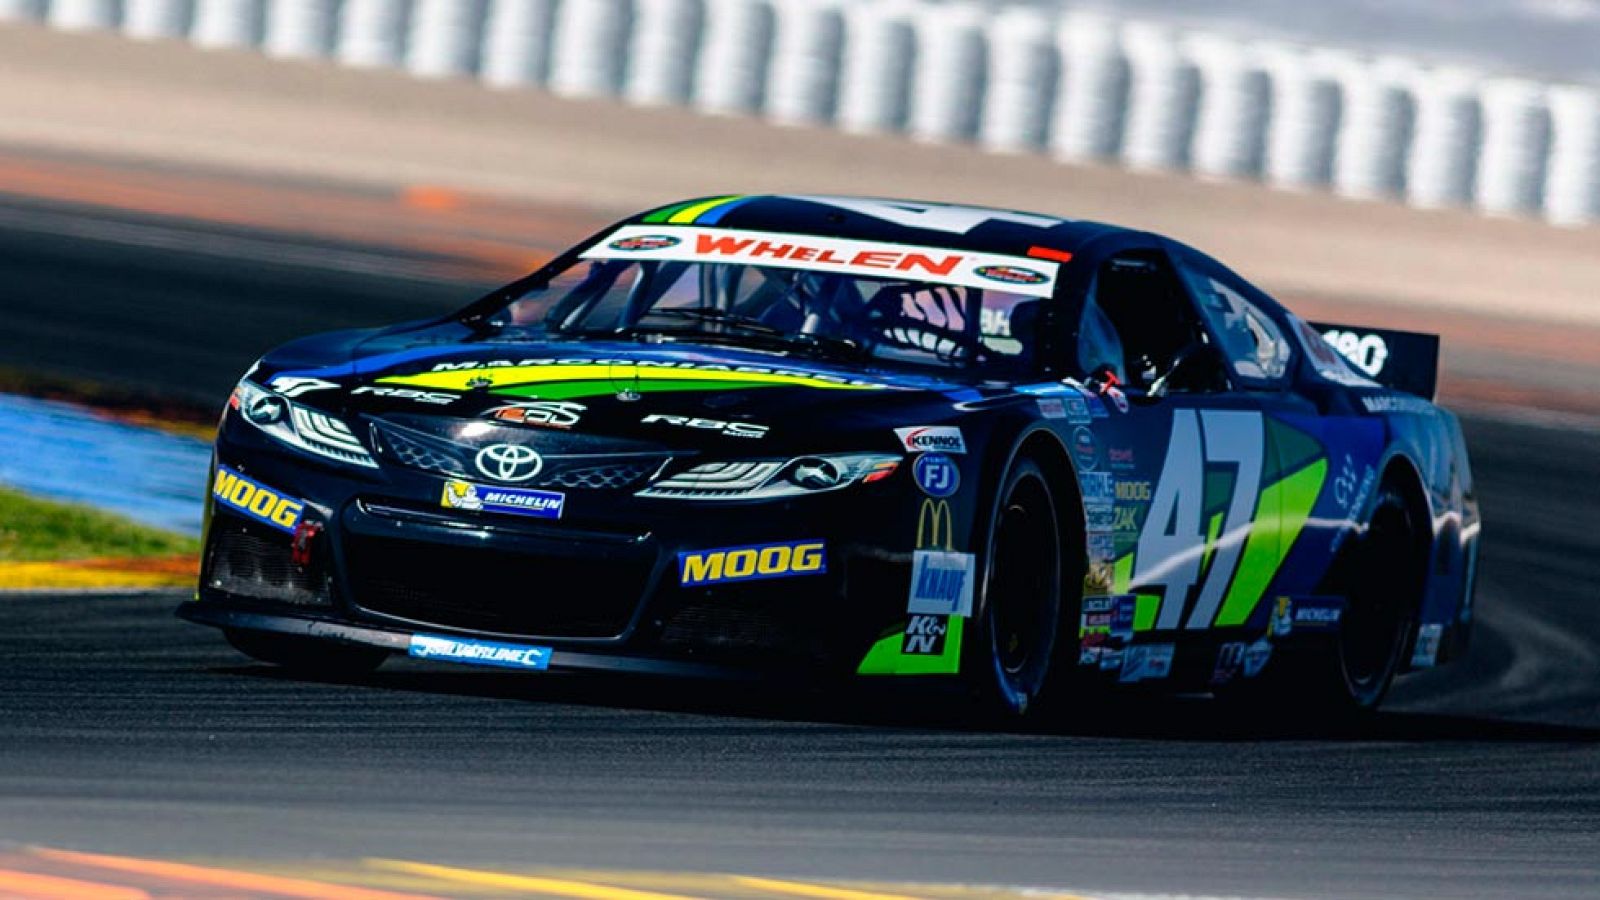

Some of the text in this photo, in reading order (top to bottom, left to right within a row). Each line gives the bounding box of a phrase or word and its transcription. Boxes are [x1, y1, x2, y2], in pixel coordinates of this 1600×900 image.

[695, 233, 963, 276] WHELEN
[913, 435, 961, 447] KENNOL
[924, 465, 949, 488] FJ
[1115, 481, 1151, 500] MOOG
[213, 468, 303, 528] MOOG
[485, 492, 561, 509] MICHELIN
[1135, 408, 1263, 630] 47
[682, 543, 824, 583] MOOG
